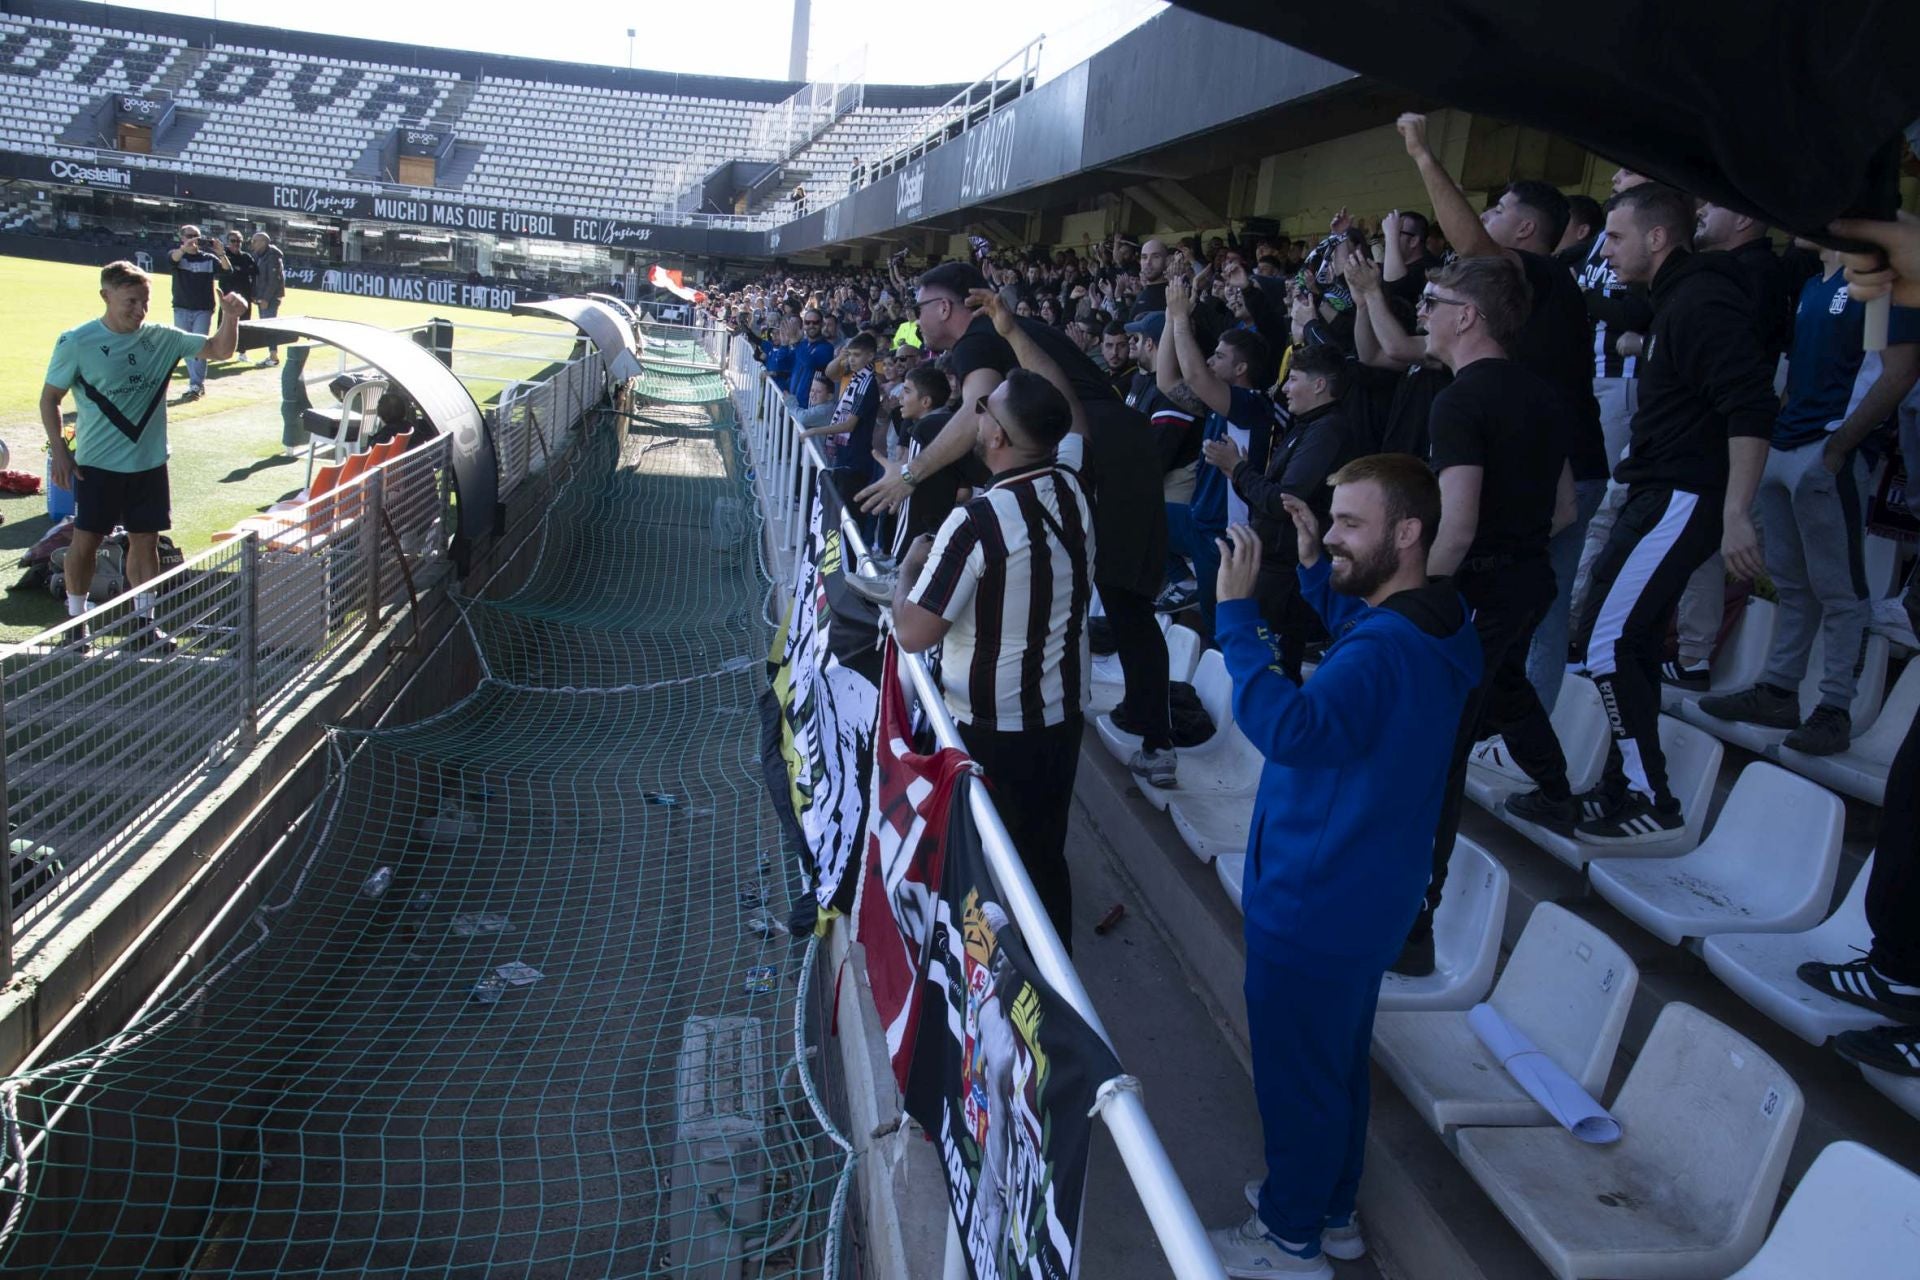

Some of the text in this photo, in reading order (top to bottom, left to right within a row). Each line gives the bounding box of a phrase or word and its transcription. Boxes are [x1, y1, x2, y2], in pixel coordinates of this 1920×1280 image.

[67, 163, 131, 185] Castellini
[273, 186, 358, 212] FCC Business
[374, 199, 427, 222] MUCHO
[432, 205, 464, 226] MAS
[467, 208, 497, 230] QUE
[573, 219, 652, 244] FCC Business
[388, 278, 424, 301] MAS
[427, 282, 457, 305] QUE
[128, 353, 137, 366] 8
